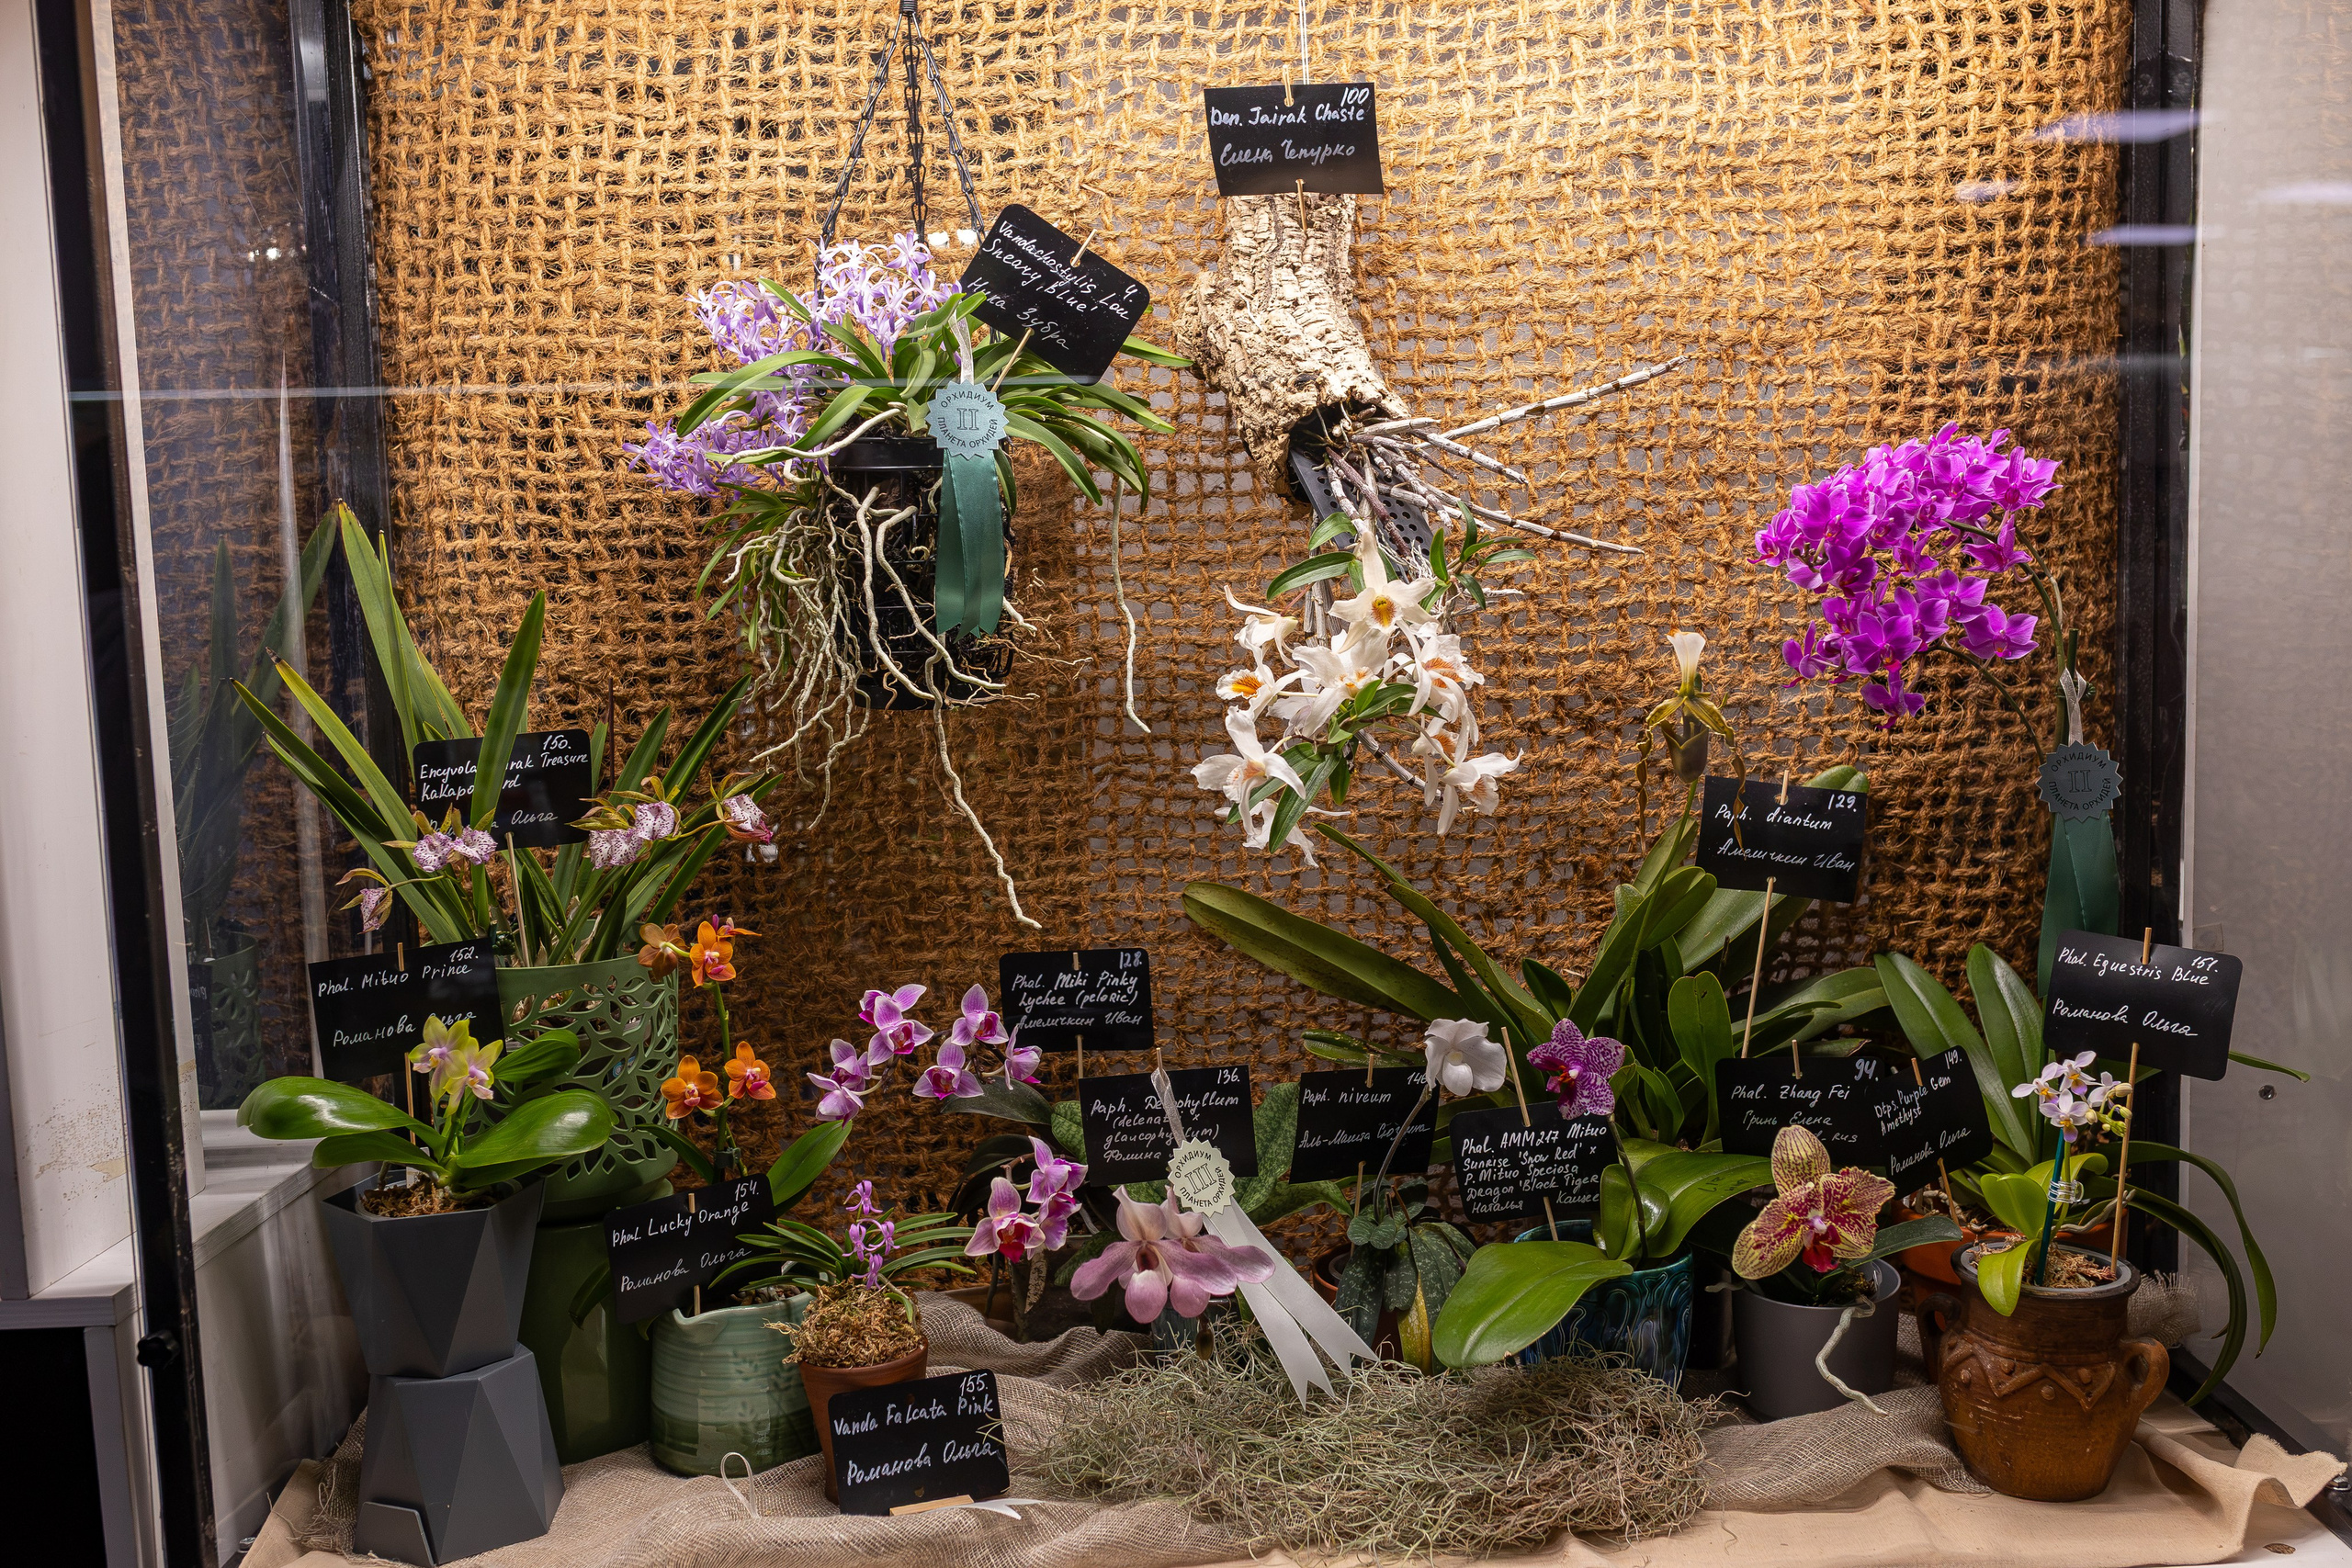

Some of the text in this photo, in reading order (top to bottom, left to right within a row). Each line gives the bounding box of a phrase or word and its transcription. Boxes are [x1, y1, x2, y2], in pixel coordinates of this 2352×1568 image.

[1340, 87, 1370, 107] 100
[1210, 103, 1365, 127] Den. Jairak Chaste
[941, 390, 994, 410] ОРХИДИУМ
[938, 417, 998, 448] ПЛАНЕТА ОРХИДЕЙ
[543, 735, 571, 750] 150.
[541, 752, 589, 768] Treasure
[2052, 752, 2107, 772] ОРХИДИУМ
[1828, 794, 1857, 812] 129.
[2049, 778, 2111, 810] ПЛАНЕТА ОРХИДЕЙ
[511, 809, 558, 825] Ольга
[1767, 807, 1832, 830] diantum
[1813, 852, 1855, 872] Иван
[2058, 946, 2086, 967] Phal.
[318, 977, 354, 997] Phal.
[422, 964, 472, 979] Prince
[1012, 970, 1138, 993] Phal. Miki Pinky
[1019, 990, 1066, 1013] Lychee
[1104, 1010, 1142, 1025] Иван
[2052, 998, 2198, 1036] Романова Ольга
[333, 1014, 416, 1047] Романова
[1854, 1058, 1879, 1082] 94.
[1945, 1049, 1962, 1069] 149.
[1216, 1067, 1240, 1085] 136.
[1303, 1087, 1392, 1107] Paph. niveum
[1731, 1083, 1850, 1108] Phal. Zhang Fei
[1897, 1085, 1928, 1105] Purple
[1930, 1076, 1951, 1090] Gem
[1091, 1097, 1132, 1122] Paph.
[1789, 1111, 1833, 1126] Елена
[1881, 1105, 1921, 1136] Amethyst
[1462, 1135, 1494, 1156] Phal.
[1566, 1122, 1607, 1139] Mituo
[1891, 1127, 1971, 1176] Романова Ольга
[1174, 1150, 1212, 1179] ОРХИДИУМ
[1479, 1168, 1520, 1182] Mituo
[1527, 1163, 1579, 1182] Speciosa
[735, 1179, 760, 1201] 154.
[1180, 1167, 1227, 1207] ПЛАНЕТА ОРХИДЕЙ
[1472, 1200, 1524, 1213] Наталья
[612, 1201, 750, 1247] Phal. Lucky Orange
[621, 1247, 752, 1292] Романова Ольга
[959, 1373, 989, 1396] 155.
[834, 1412, 878, 1436] Vanda
[957, 1393, 993, 1416] Pink
[847, 1439, 998, 1486] Романова Ольга
